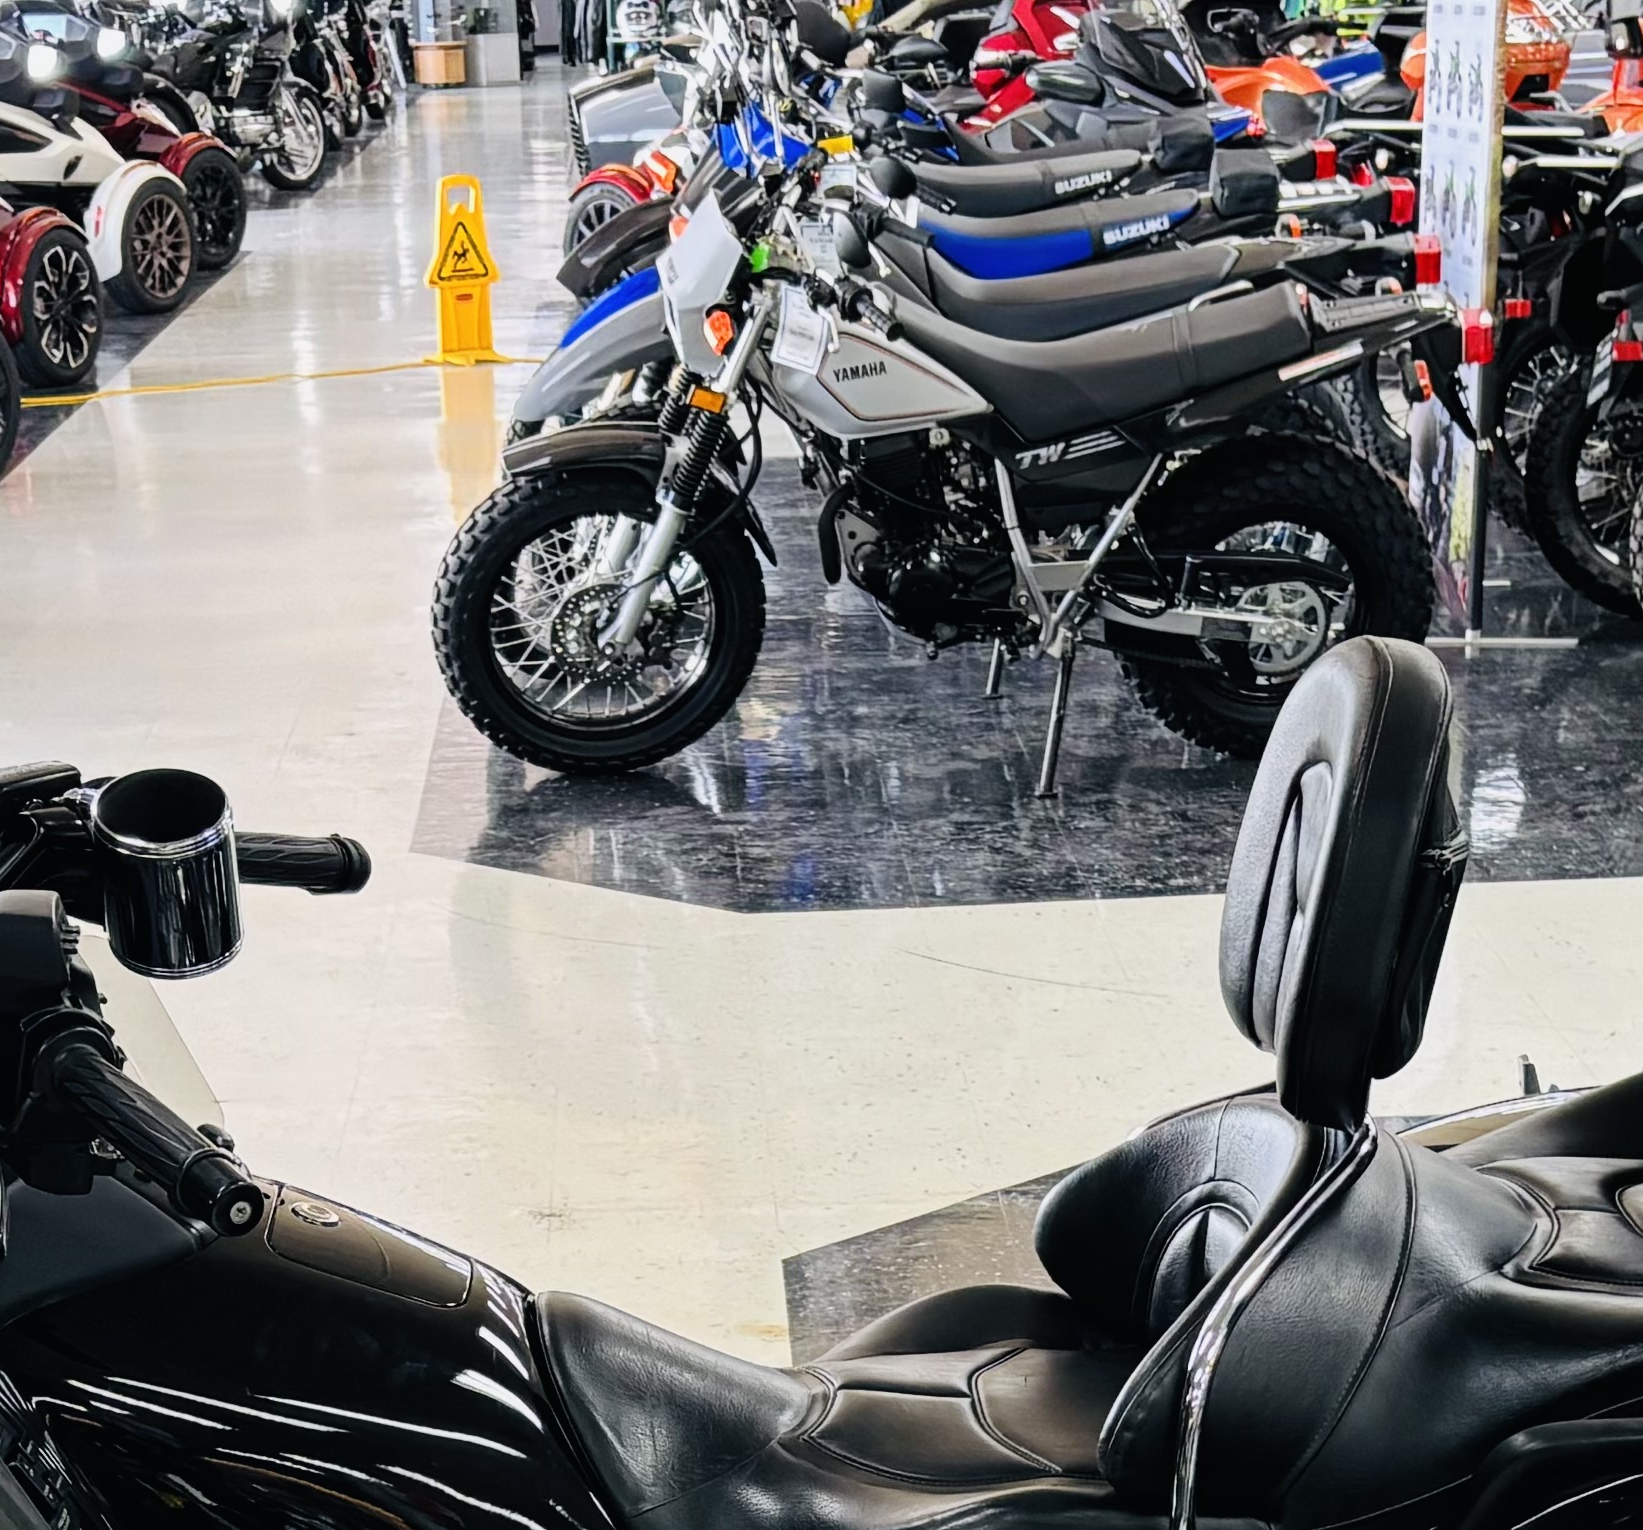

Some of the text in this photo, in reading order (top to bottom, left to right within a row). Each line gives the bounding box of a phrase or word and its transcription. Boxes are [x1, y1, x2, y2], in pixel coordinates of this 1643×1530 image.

[1055, 169, 1112, 195] SUZUKI
[1103, 213, 1170, 245] SUZUKI
[833, 361, 887, 383] YAMAHA
[1015, 442, 1066, 469] TW
